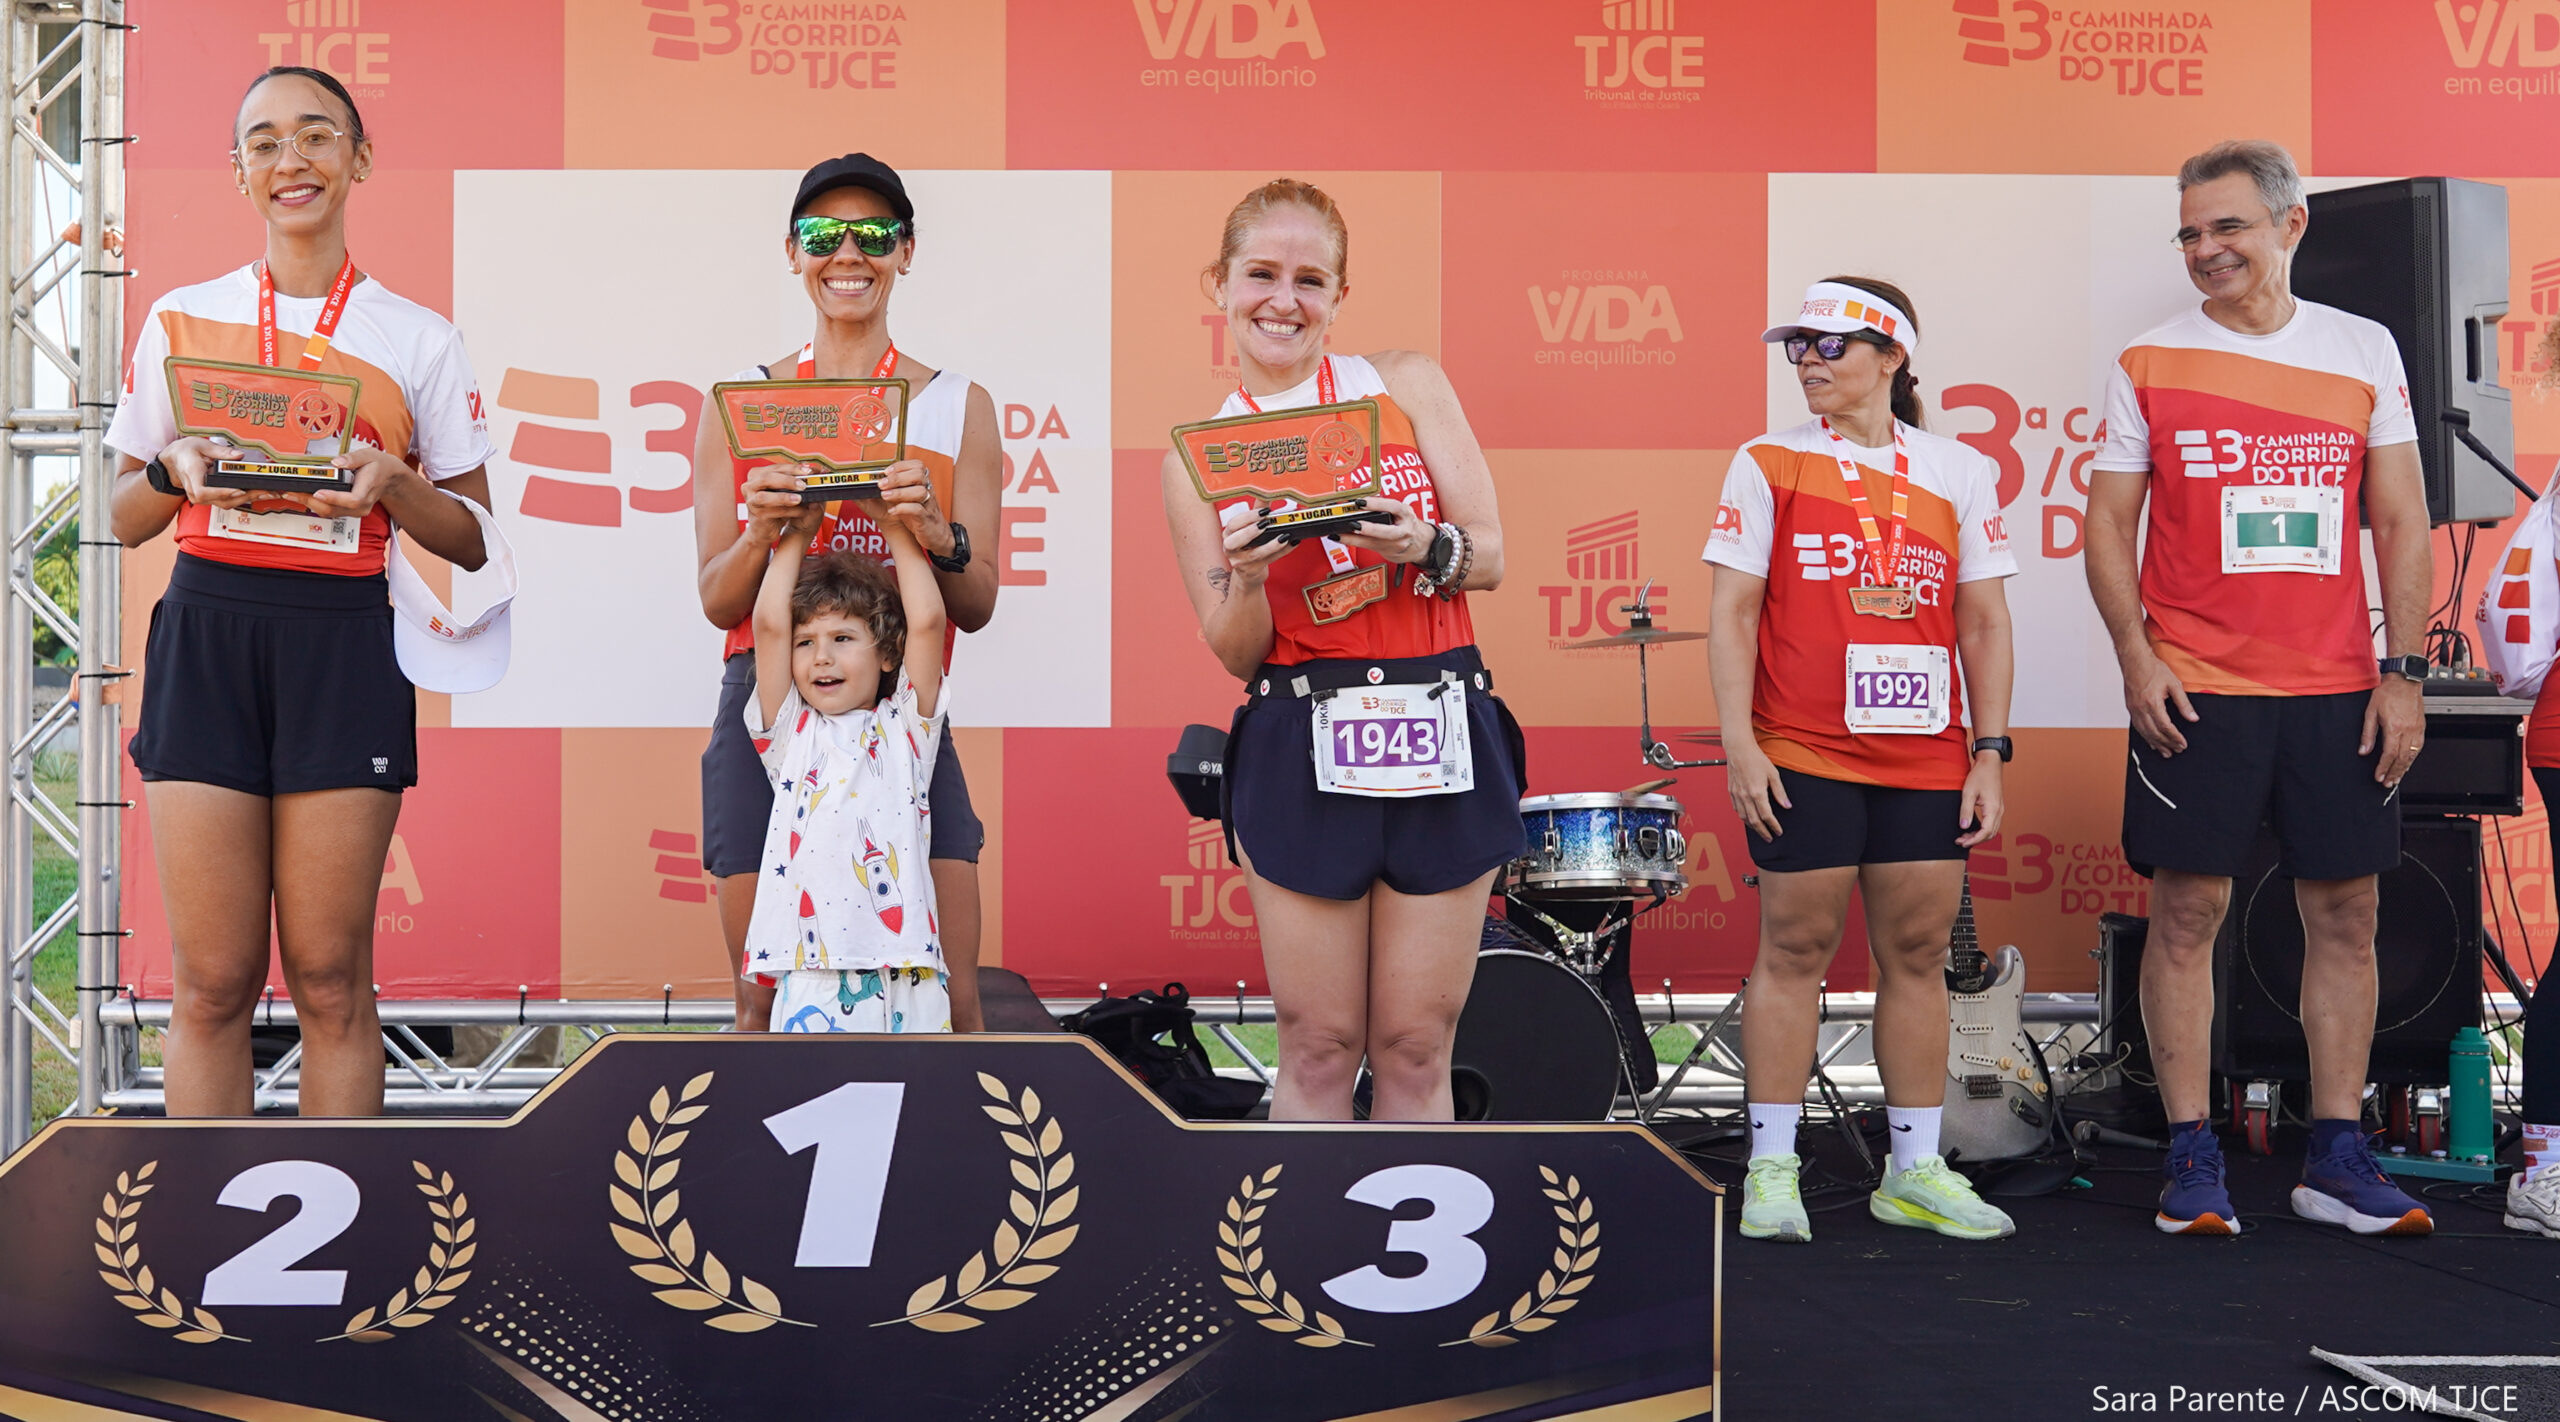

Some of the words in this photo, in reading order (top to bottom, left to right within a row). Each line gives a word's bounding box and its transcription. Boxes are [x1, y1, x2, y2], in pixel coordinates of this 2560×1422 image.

[760, 4, 907, 22] CAMINHADA
[2069, 11, 2213, 30] CAMINHADA
[750, 23, 902, 47] /CORRIDA
[1132, 0, 1327, 60] VIDA
[2059, 30, 2208, 54] /CORRIDA
[751, 49, 796, 75] DO
[801, 52, 896, 90] TJCE
[1574, 35, 1705, 88] TJCE
[1141, 69, 1179, 87] em
[1185, 61, 1317, 94] equilíbrio
[2060, 56, 2104, 82] DO
[2109, 58, 2203, 96] TJCE
[2444, 77, 2482, 95] em
[1584, 89, 1635, 102] Tribunal
[1639, 89, 1655, 102] de
[1658, 89, 1700, 103] Justiça
[1527, 285, 1684, 343] VIDA
[1535, 350, 1565, 365] em
[1570, 344, 1676, 371] equilíbrio
[232, 389, 291, 403] CAMINHADA
[249, 411, 286, 428] TJCE
[785, 404, 841, 415] CAMINHADA
[800, 423, 839, 440] TJCE
[1249, 435, 1308, 450] CAMINHADA
[2215, 429, 2253, 473] 3ª
[2256, 432, 2355, 448] CAMINHADA
[2251, 445, 2350, 465] /CORRIDA
[268, 466, 299, 475] LUGAR
[1271, 455, 1309, 475] TJCE
[2252, 465, 2285, 485] DO
[830, 474, 860, 484] LUGAR
[1301, 508, 1333, 521] LUGAR
[2271, 513, 2286, 544] 1
[1857, 673, 1929, 707] 1992
[1337, 720, 1437, 764] 1943
[2060, 888, 2105, 915] DO
[1169, 928, 1221, 941] Tribunal
[1225, 928, 1241, 941] de
[762, 1082, 905, 1268] 1
[201, 1160, 361, 1307] 2
[1320, 1165, 1495, 1313] 3
